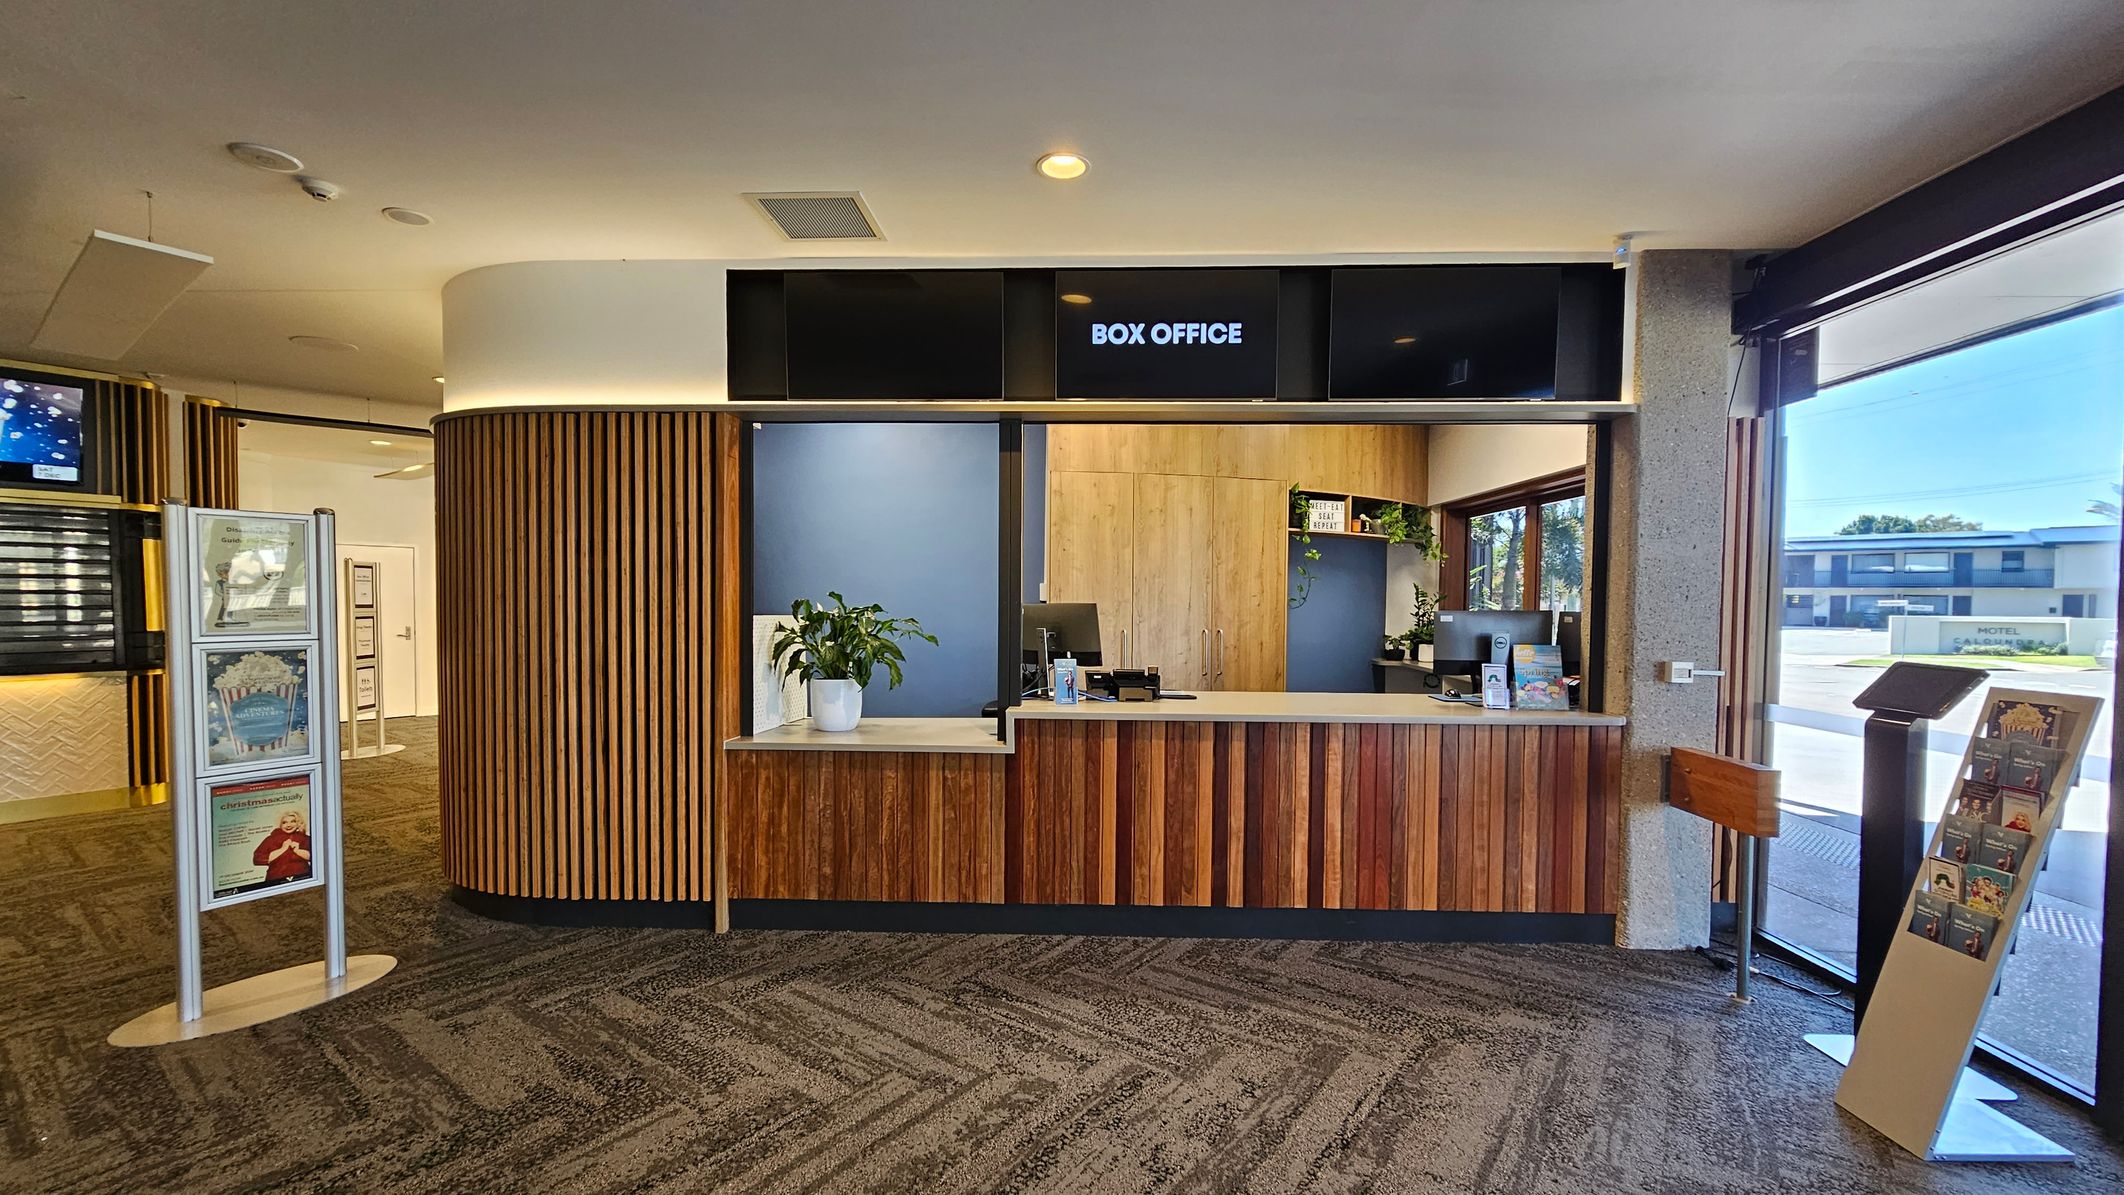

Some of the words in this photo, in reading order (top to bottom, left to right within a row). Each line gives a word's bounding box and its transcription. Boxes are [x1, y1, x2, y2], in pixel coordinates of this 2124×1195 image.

[1092, 323, 1146, 345] BOX
[1150, 322, 1243, 345] OFFICE
[1318, 512, 1335, 520] SEAT
[1313, 521, 1337, 530] REPEAT
[1977, 627, 2021, 636] MOTEL
[1952, 637, 2047, 646] CALOUNDRA
[235, 710, 286, 719] ADVENTURES
